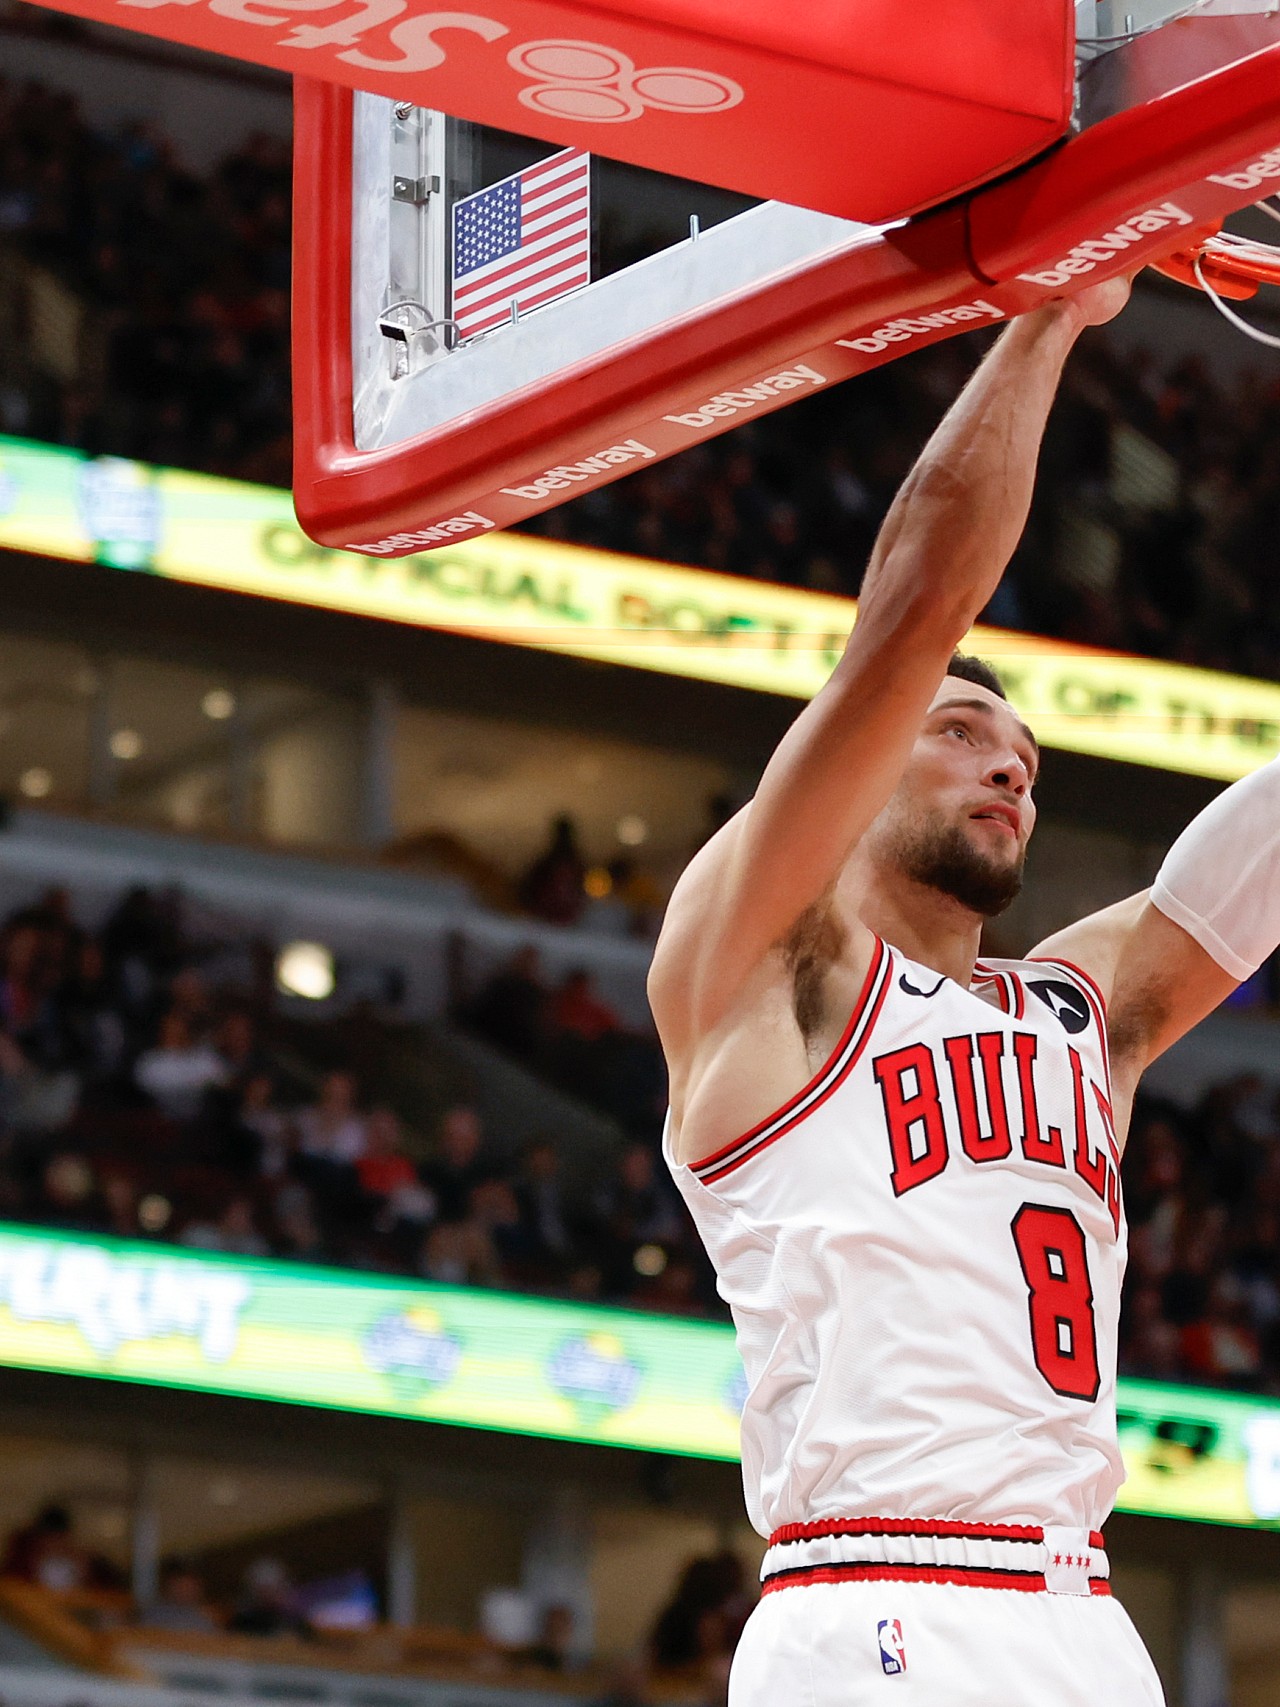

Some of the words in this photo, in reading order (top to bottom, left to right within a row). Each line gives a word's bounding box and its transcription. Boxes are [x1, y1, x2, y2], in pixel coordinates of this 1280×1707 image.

[346, 511, 496, 555] betway
[499, 439, 657, 500] betway
[662, 363, 827, 428] betway
[834, 300, 1006, 353] betway
[1016, 201, 1194, 287] betway
[872, 1031, 1121, 1245] BULLS
[1011, 1202, 1101, 1404] 8
